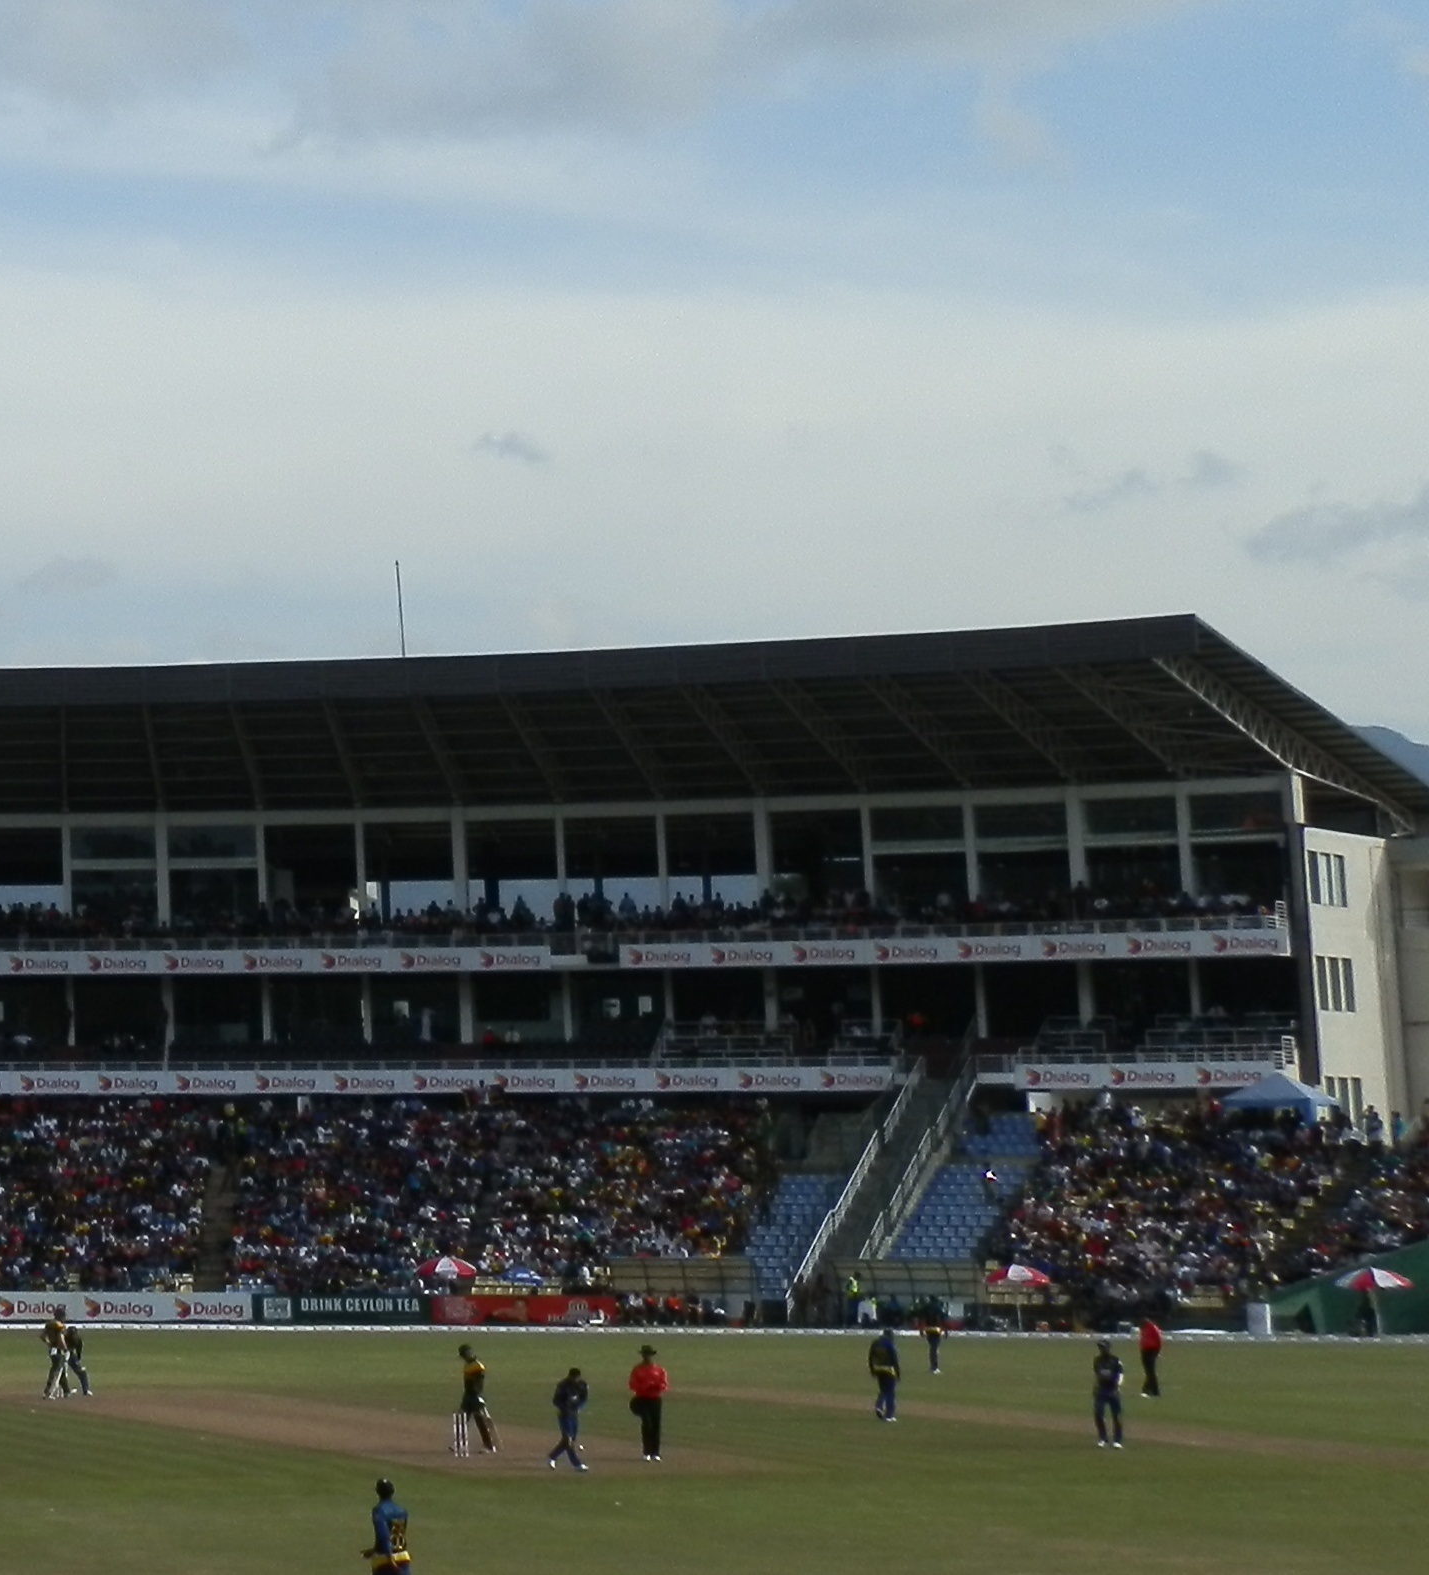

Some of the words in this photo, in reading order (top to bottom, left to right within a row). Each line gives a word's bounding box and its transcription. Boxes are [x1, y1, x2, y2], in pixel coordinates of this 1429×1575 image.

[974, 943, 1021, 957] Dialog
[1059, 940, 1106, 955] Dialog
[1143, 939, 1191, 953] Dialog
[1229, 937, 1278, 951] Dialog
[645, 951, 690, 964] Dialog
[728, 949, 773, 963] Dialog
[809, 947, 855, 960] Dialog
[892, 945, 937, 960] Dialog
[26, 958, 68, 971] Dialog
[103, 957, 146, 971] Dialog
[181, 957, 224, 969] Dialog
[260, 956, 303, 969] Dialog
[338, 955, 381, 968] Dialog
[417, 955, 461, 967] Dialog
[496, 954, 540, 967] Dialog
[37, 1078, 80, 1090] Dialog
[193, 1077, 236, 1091] Dialog
[272, 1076, 315, 1089] Dialog
[350, 1077, 394, 1090] Dialog
[429, 1076, 473, 1089] Dialog
[511, 1075, 555, 1089] Dialog
[590, 1075, 635, 1089] Dialog
[673, 1075, 718, 1088] Dialog
[755, 1074, 801, 1088] Dialog
[837, 1073, 883, 1087] Dialog
[1043, 1070, 1090, 1085] Dialog
[1127, 1070, 1175, 1084] Dialog
[115, 1078, 157, 1091] Dialog
[104, 1301, 153, 1317] Dialog
[194, 1302, 243, 1318] Dialog
[301, 1298, 342, 1312] DRINK
[346, 1298, 393, 1312] CEYLON
[397, 1298, 420, 1312] TEA
